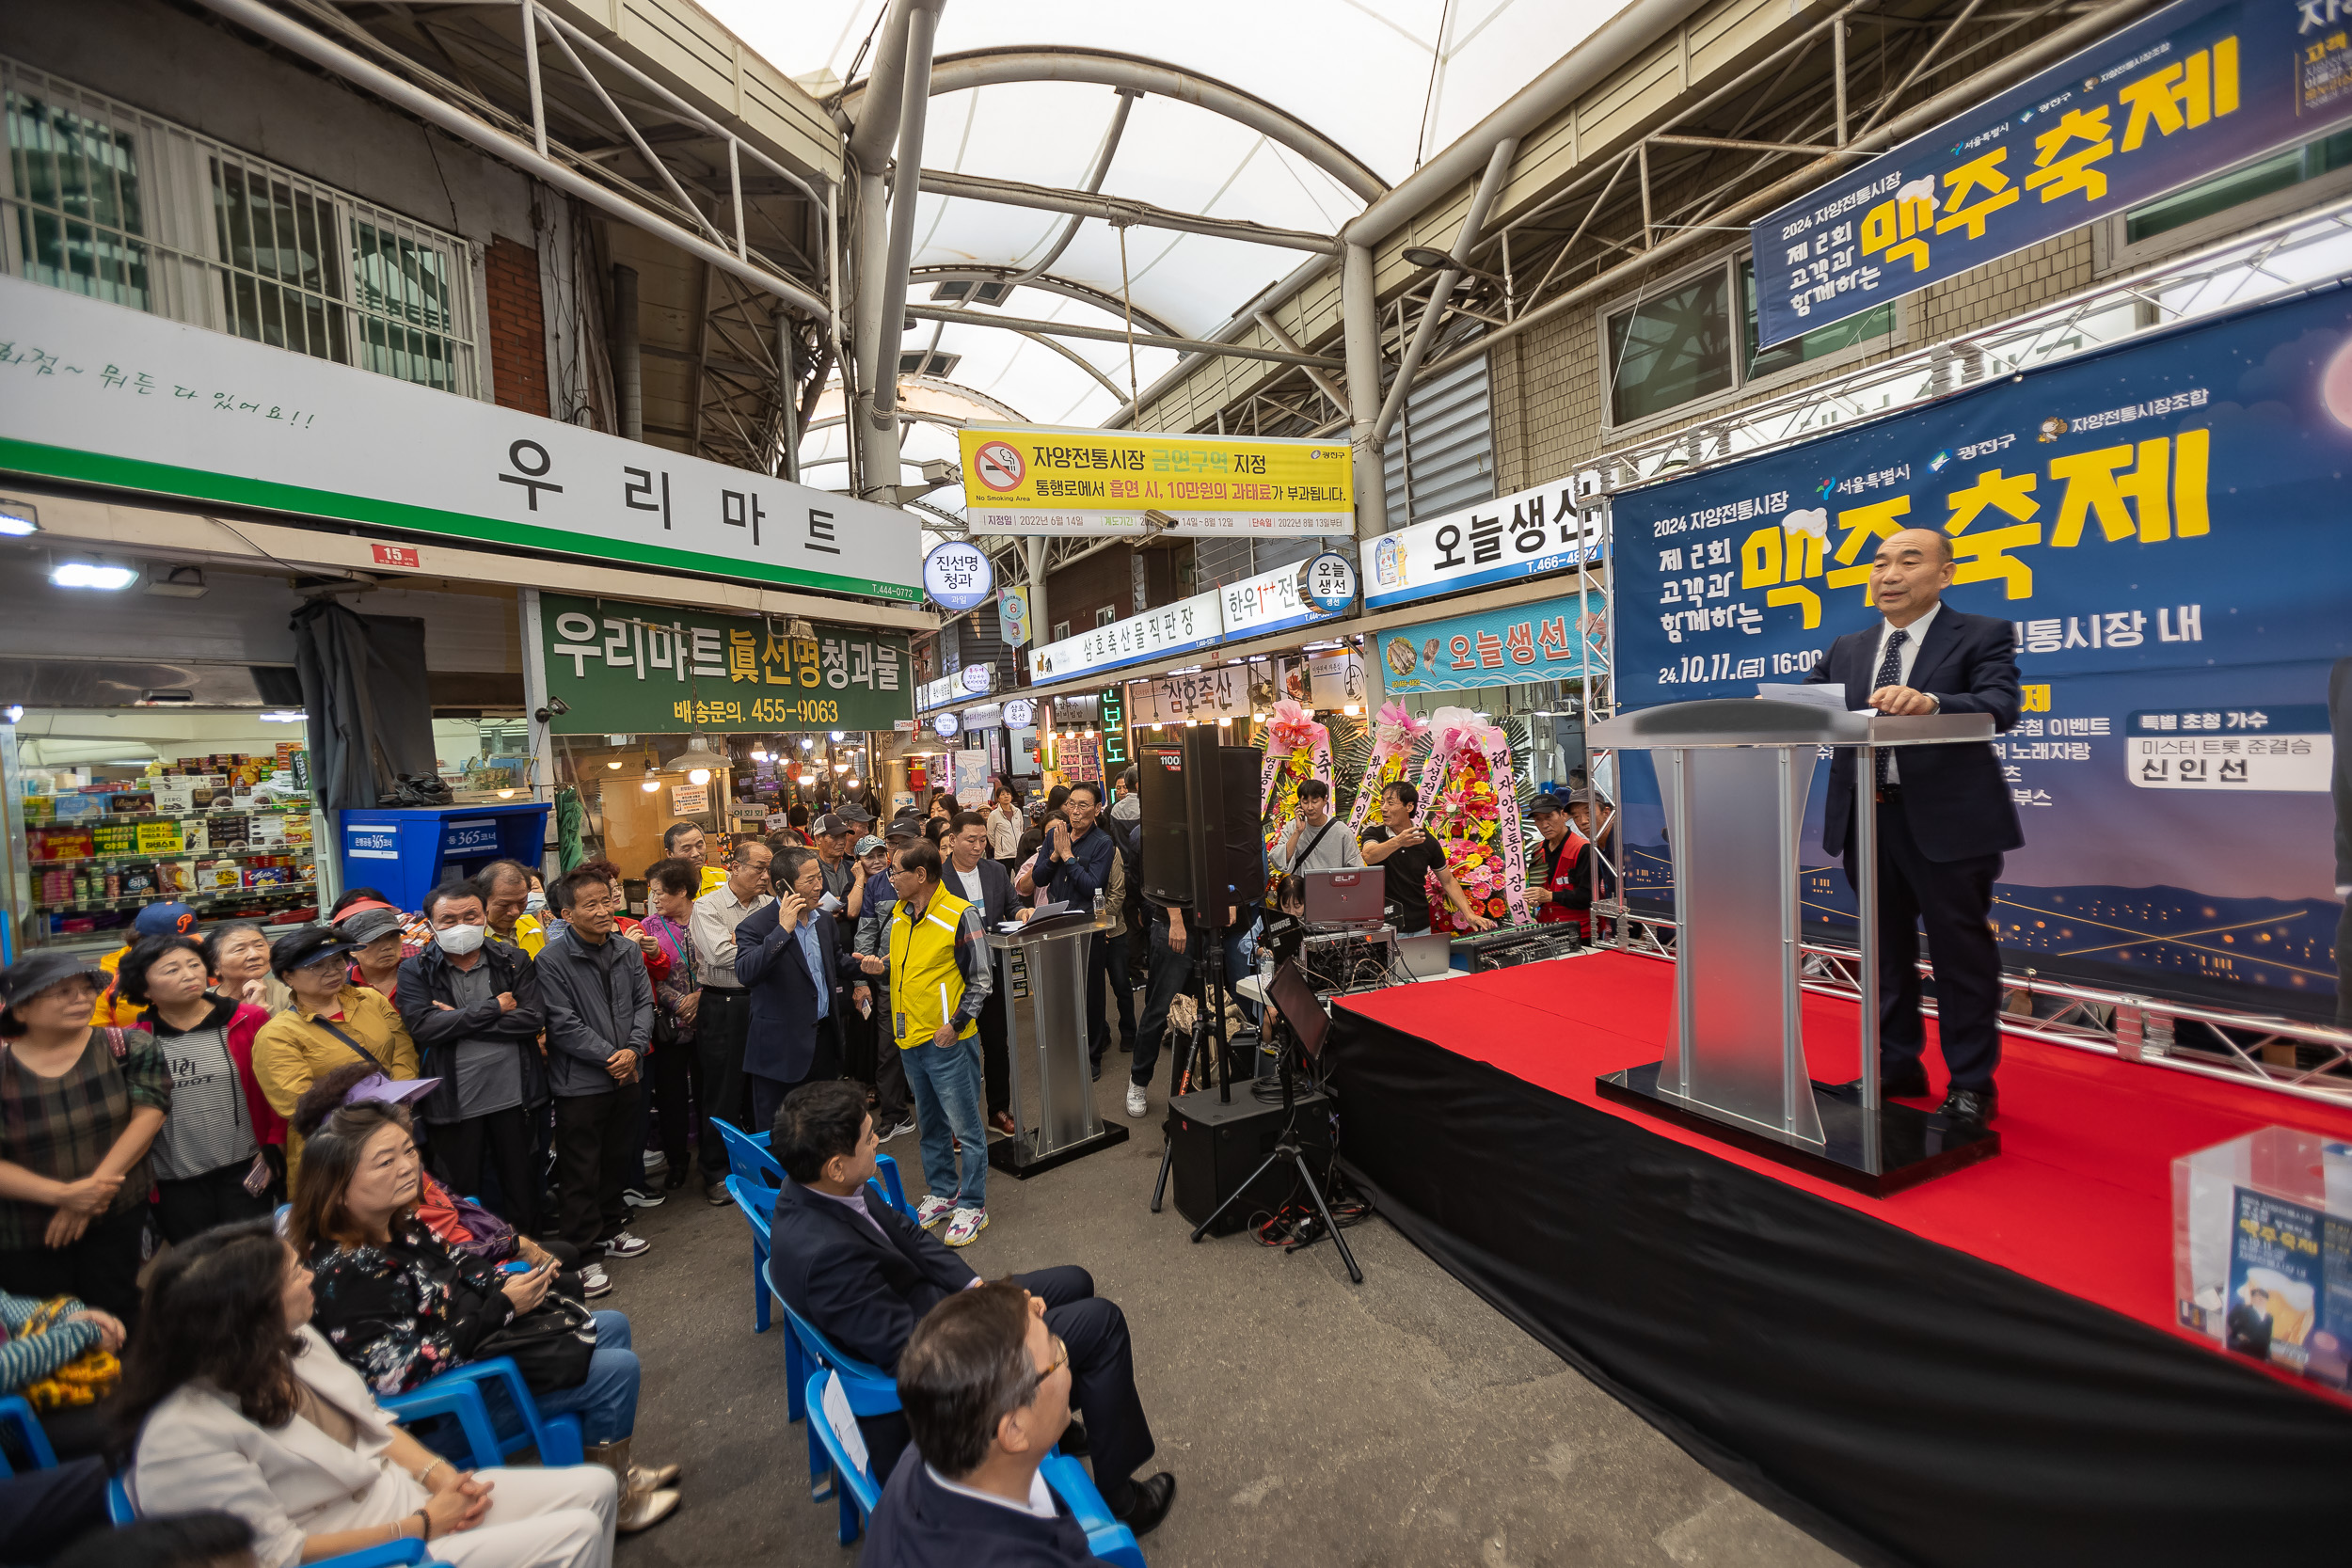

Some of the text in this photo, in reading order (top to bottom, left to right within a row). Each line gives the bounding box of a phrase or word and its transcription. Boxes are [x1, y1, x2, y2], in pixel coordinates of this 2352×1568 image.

[1964, 122, 2009, 150] 서울특별시
[2038, 91, 2072, 113] 광진구
[1782, 170, 1901, 241] 2024 자양전통시장
[1787, 220, 1851, 266] 제 2회
[1789, 245, 1855, 290] 고객과
[1790, 265, 1882, 317] 함께하는
[173, 385, 199, 399] 다
[1836, 388, 2210, 496] 서울특별시 광진구 자양전통시장조합
[1033, 446, 1266, 475] 자양전통시장 금연구역 지정
[1322, 451, 1345, 460] 광진구
[987, 495, 1013, 503] Smoking
[1035, 479, 1105, 499] 통행로에서
[1109, 480, 1140, 499] 흡연
[1168, 481, 1229, 500] 10만원의
[1287, 483, 1346, 503] 부과됩니다.
[1020, 516, 1049, 526] 2022년
[1050, 516, 1064, 526] 6월
[1066, 516, 1083, 527] 14일
[1217, 517, 1233, 528] 12일
[1252, 517, 1343, 528] 단속일 2022년 8월 13일부터
[1653, 490, 1789, 538] 2024 자양전통시장
[384, 547, 403, 562] 15
[936, 555, 978, 572] 진선명
[1659, 537, 1731, 572] 제 2회
[1318, 562, 1345, 578] 오늘
[871, 582, 914, 598] T.444-0772
[944, 574, 973, 590] 청과
[1318, 579, 1346, 594] 생선
[1660, 571, 1734, 609] 고객과
[951, 595, 967, 605] 과일
[1009, 603, 1017, 613] 6
[1326, 598, 1341, 607] 생선
[1661, 602, 1763, 643] 함께하는
[2156, 604, 2202, 642] 내
[1084, 605, 1194, 662] 삼호축산물직판장
[1449, 615, 1571, 671] 오늘생선
[1772, 649, 1824, 674] 16:00
[1168, 672, 1233, 714] 삼호축산
[751, 698, 838, 723] 455-9063
[2050, 717, 2111, 736] 이벤트
[2142, 711, 2268, 730] 특별 초청 가수
[2012, 742, 2091, 761] 노래자랑
[2142, 738, 2312, 755] 미스터 트롯 준결승
[1491, 749, 1510, 770] 祝
[1498, 775, 1526, 893] 자양전통시장
[145, 840, 177, 849] 하베스트
[177, 914, 193, 933] P
[1270, 917, 1291, 932] SHURE
